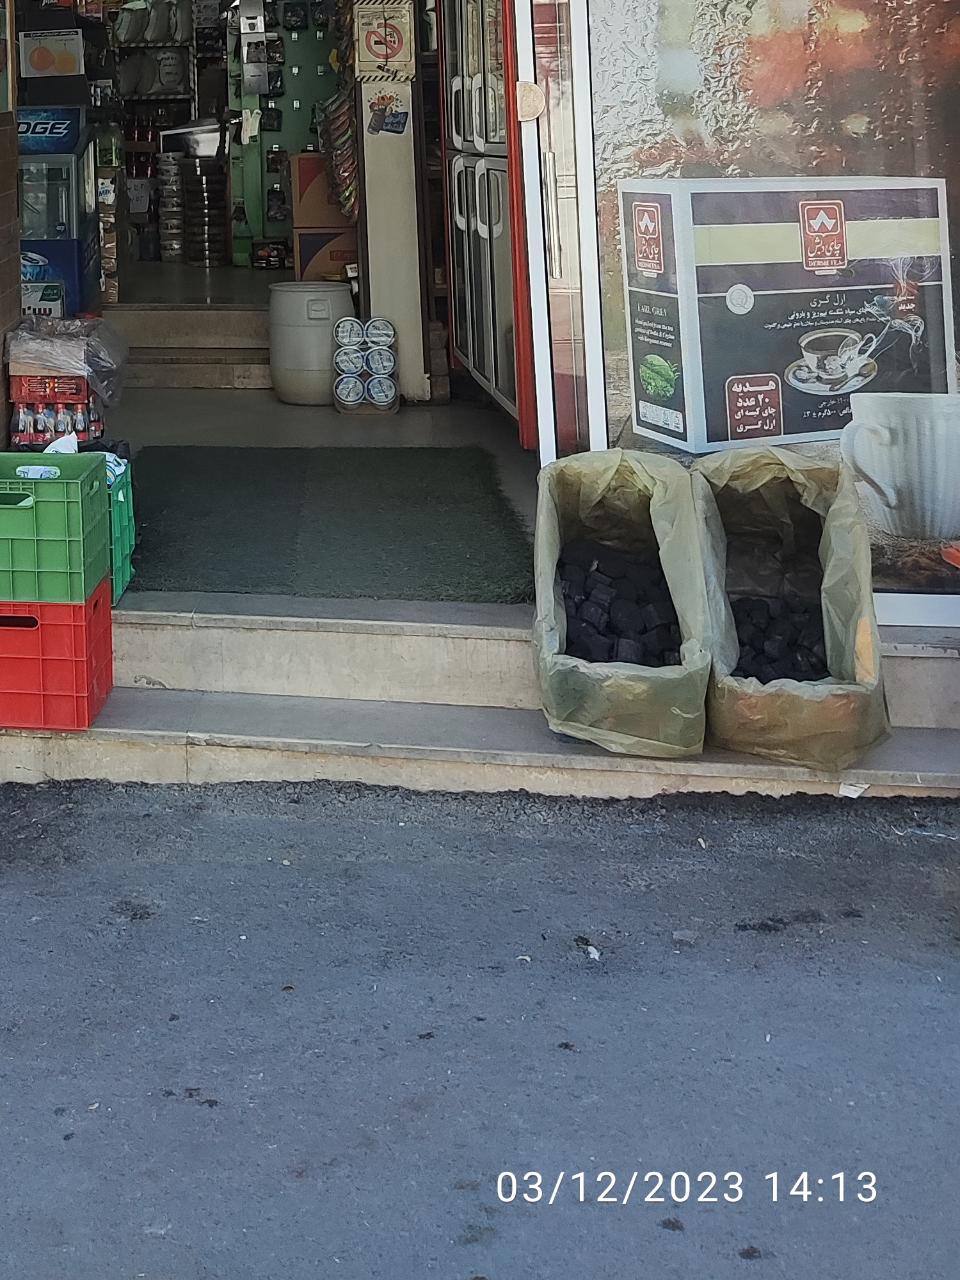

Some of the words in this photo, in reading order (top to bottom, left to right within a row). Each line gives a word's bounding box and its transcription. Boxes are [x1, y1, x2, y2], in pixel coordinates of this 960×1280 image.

[732, 380, 776, 395] هدیه
[736, 397, 755, 407] عدد
[757, 394, 769, 406] ۲۰
[745, 408, 760, 417] کیسه
[762, 407, 776, 416] چای
[736, 420, 762, 432] گری
